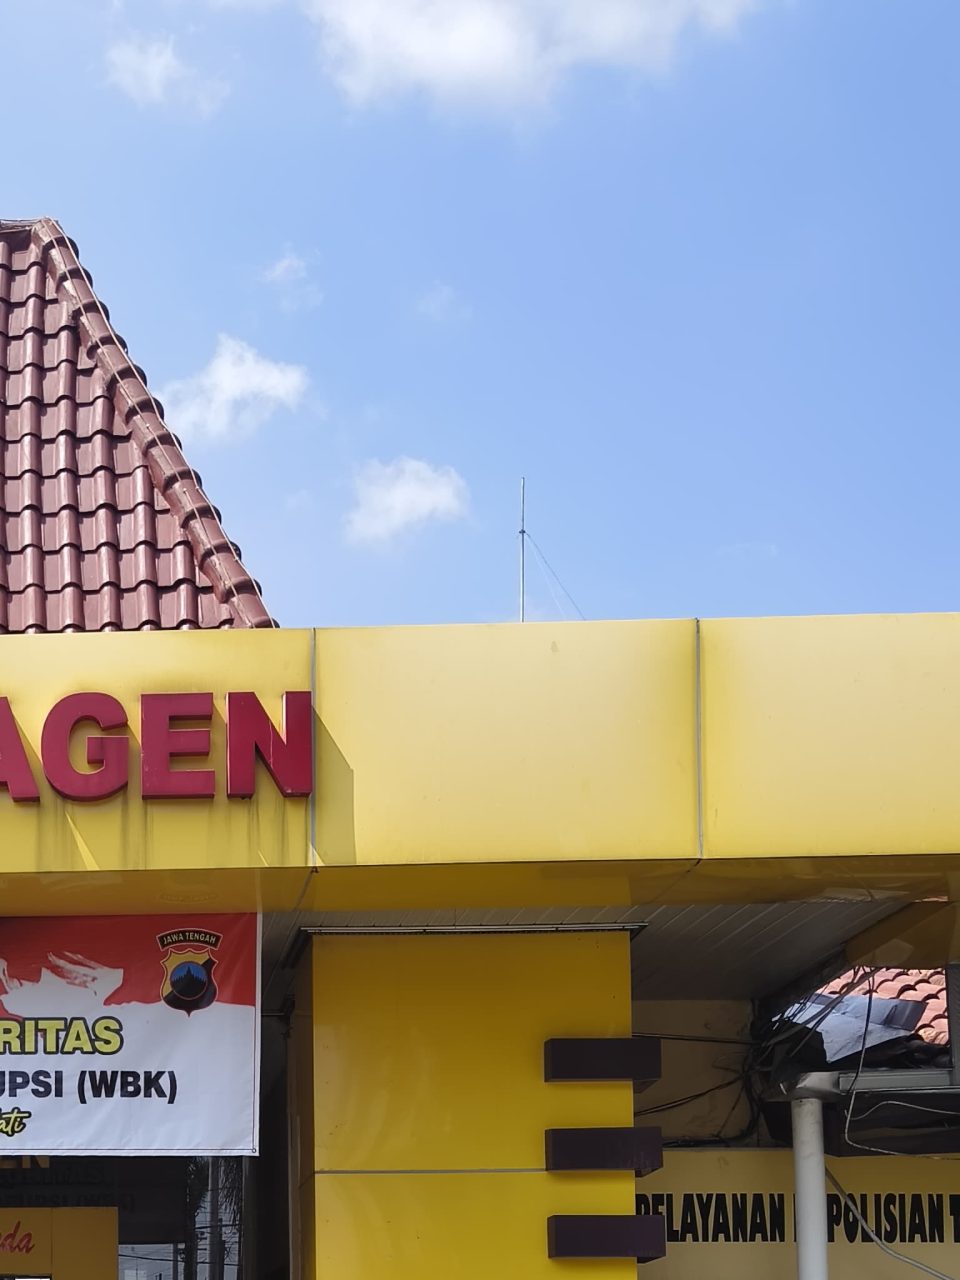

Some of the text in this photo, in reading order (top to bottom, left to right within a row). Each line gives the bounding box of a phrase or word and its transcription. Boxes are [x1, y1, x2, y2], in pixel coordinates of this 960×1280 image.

[163, 932, 217, 945] JAWA TENGAH
[77, 1070, 178, 1104] (WBK)
